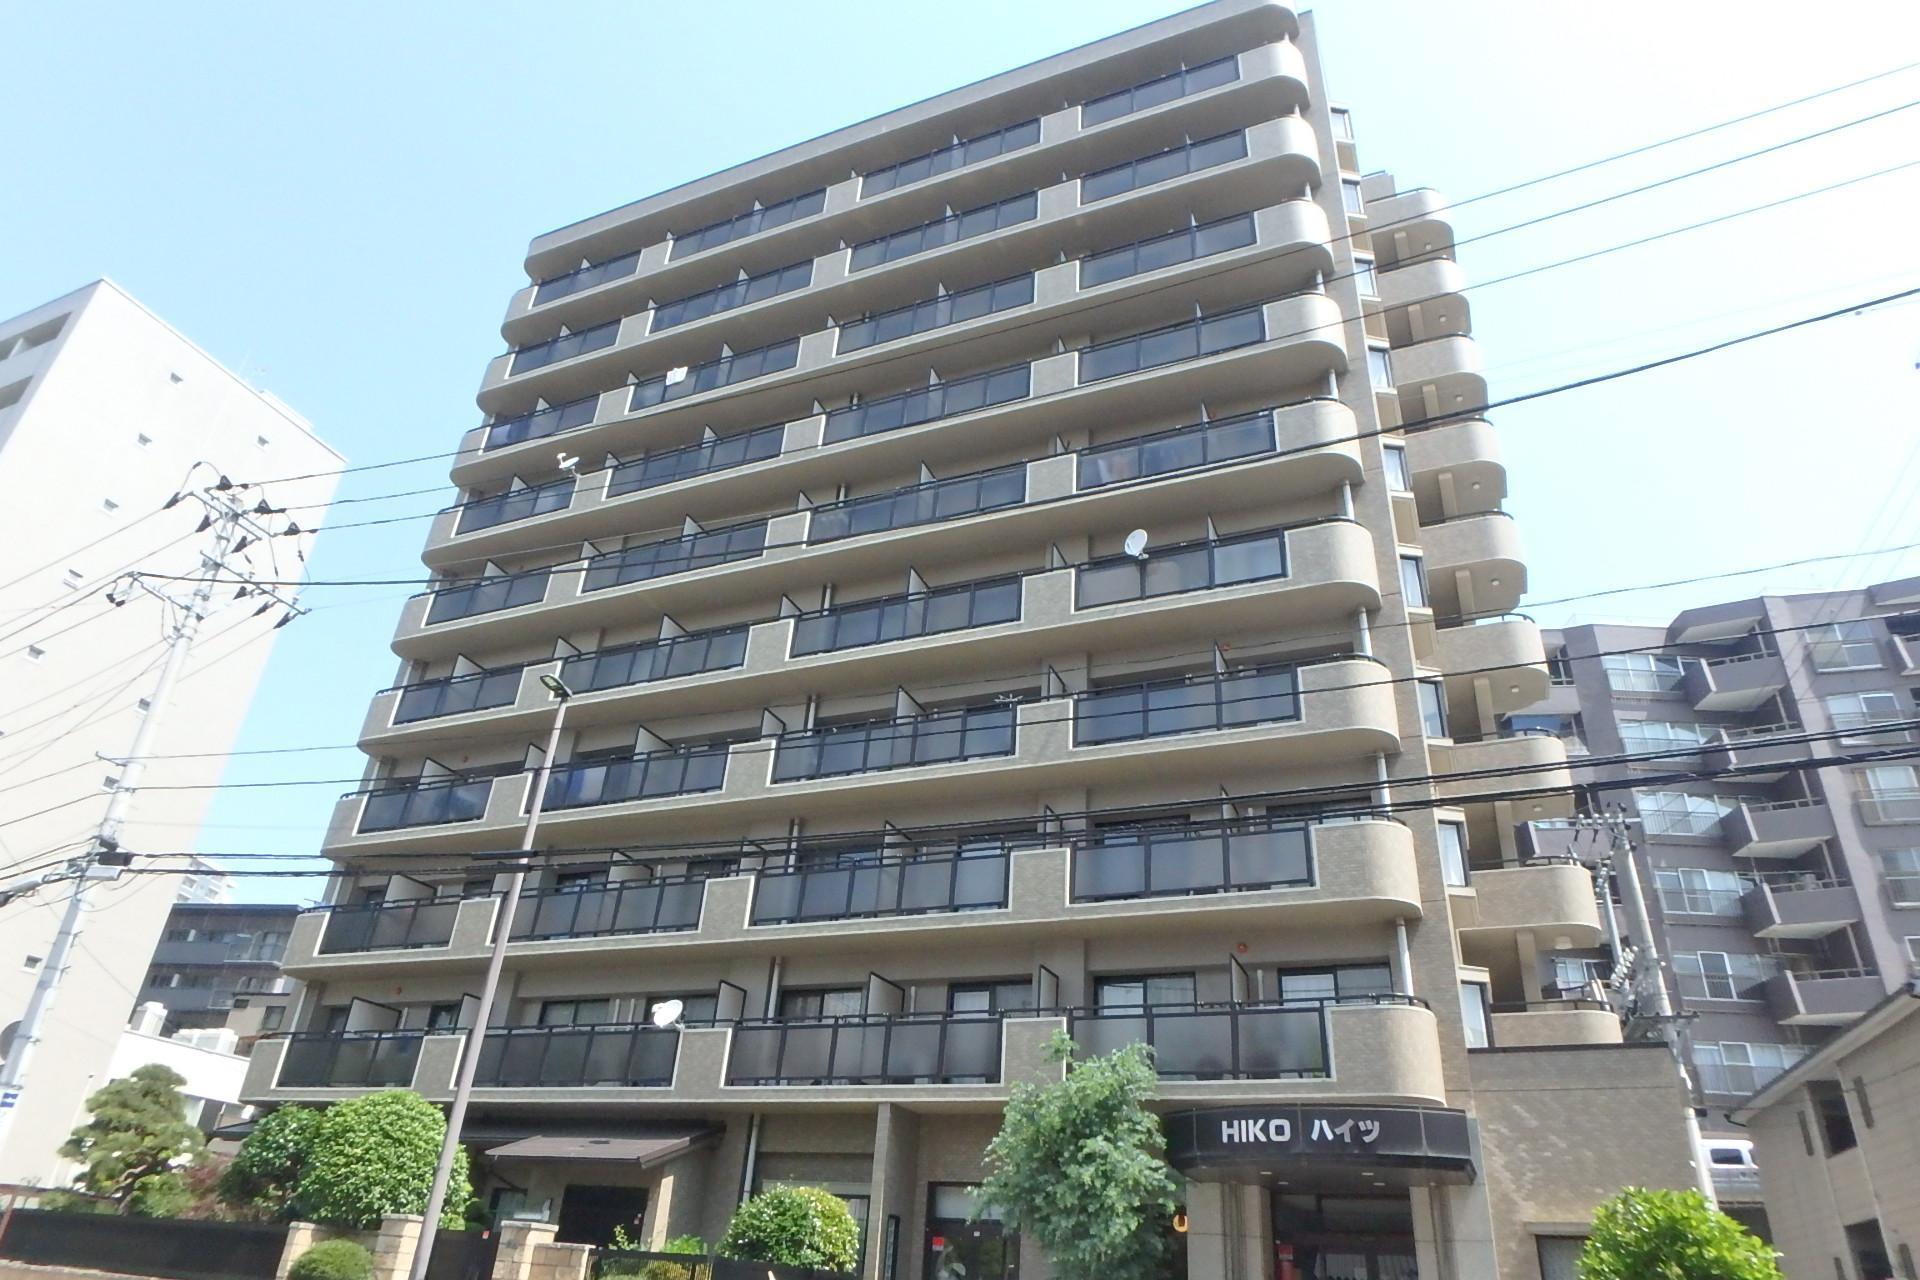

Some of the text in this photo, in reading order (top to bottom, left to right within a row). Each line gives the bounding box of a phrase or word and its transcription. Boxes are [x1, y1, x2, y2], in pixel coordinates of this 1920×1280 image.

[1221, 1118, 1380, 1143] HIKO ハイツ
